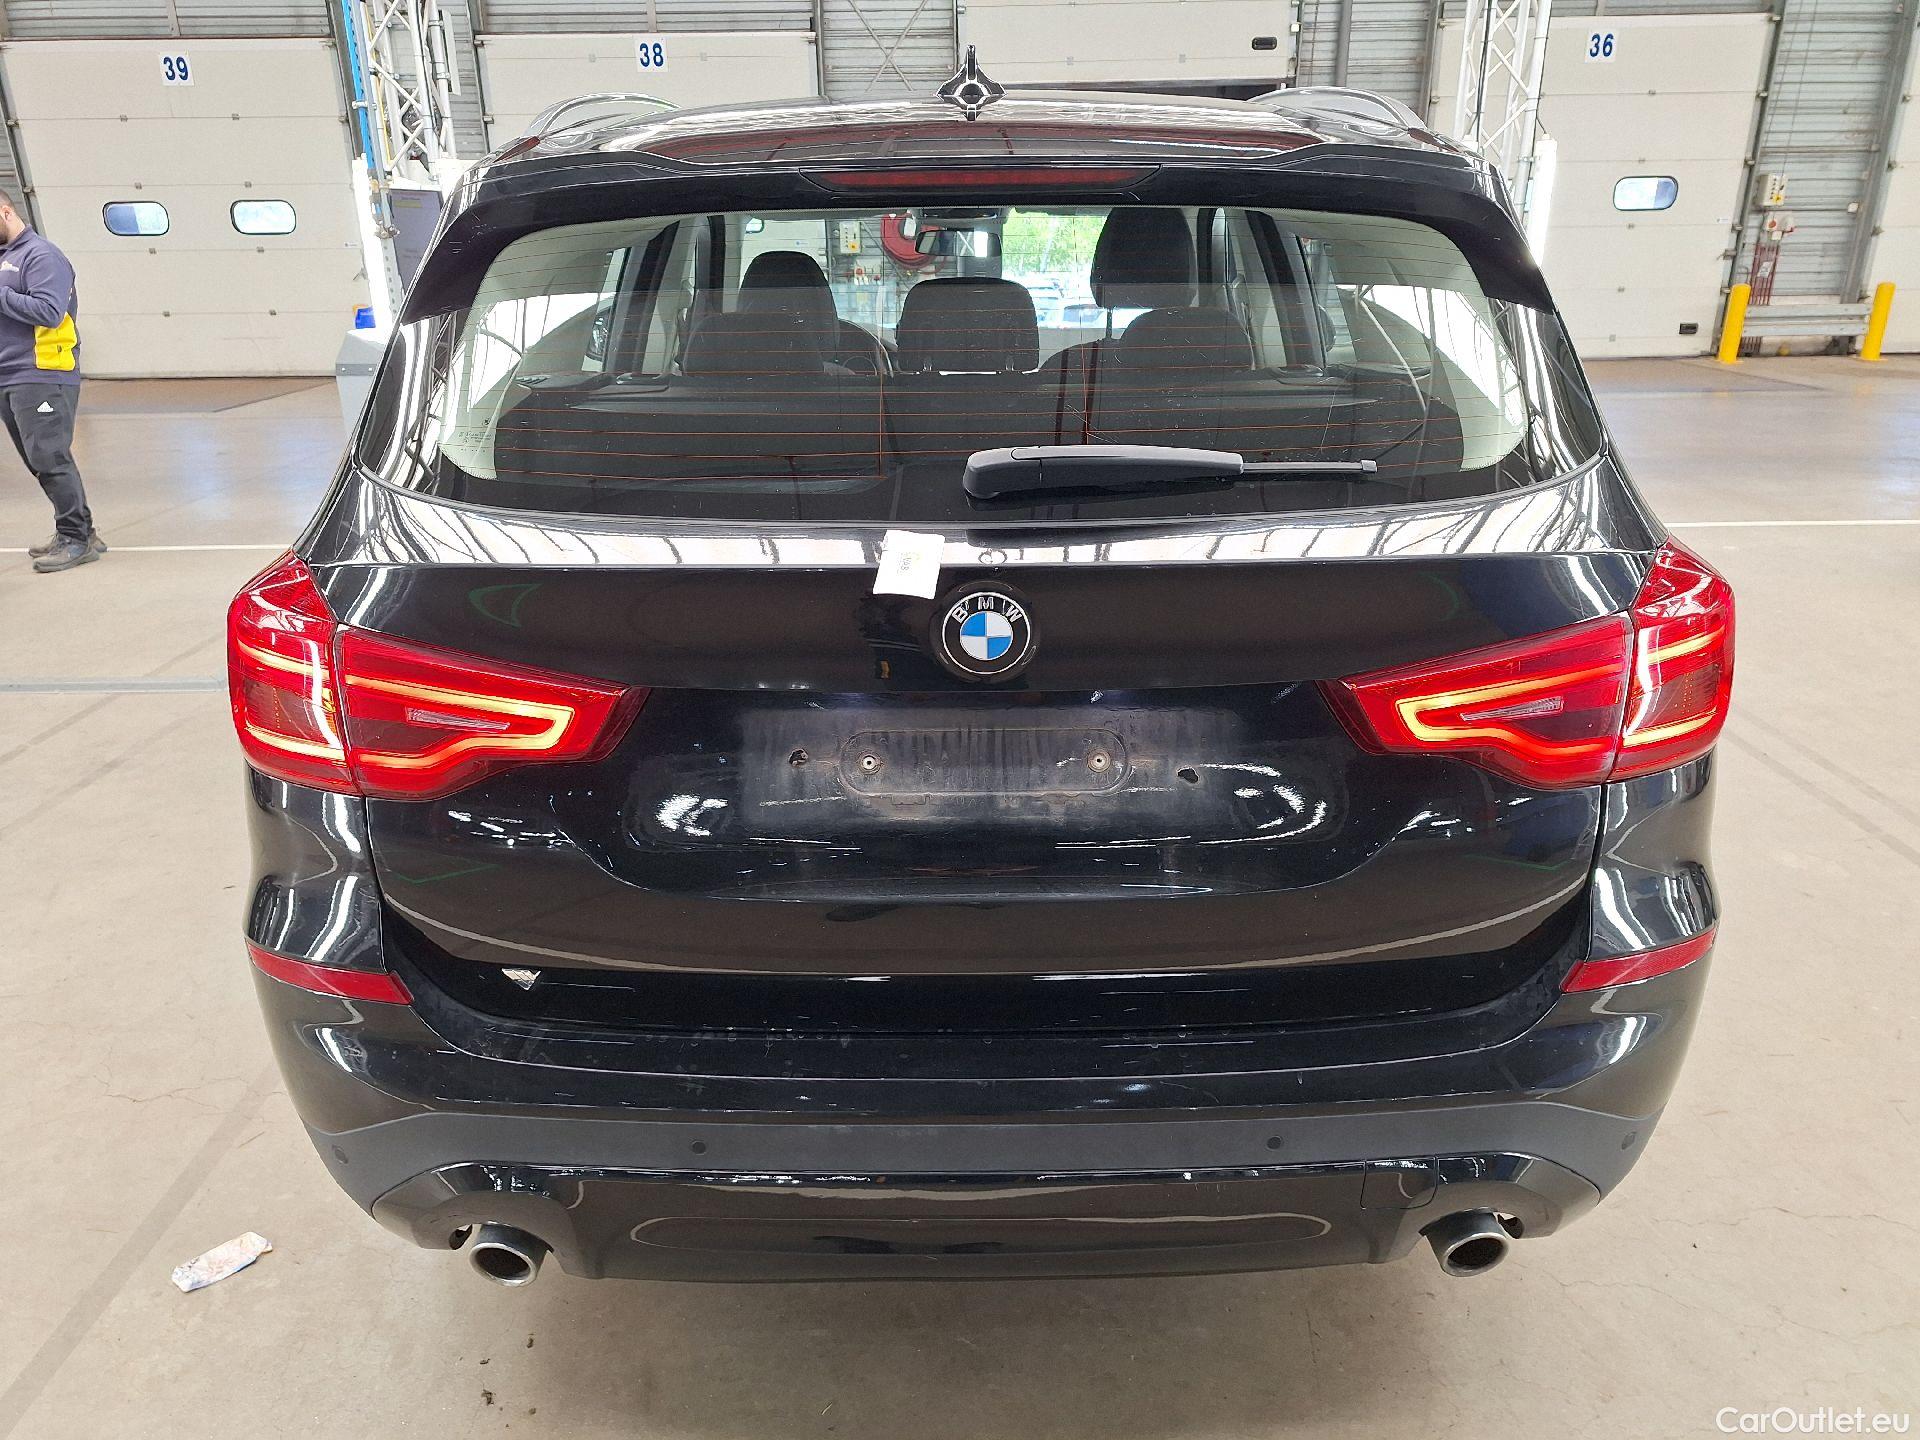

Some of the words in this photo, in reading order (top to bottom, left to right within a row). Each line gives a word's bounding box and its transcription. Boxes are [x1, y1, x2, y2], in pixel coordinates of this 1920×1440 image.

[639, 42, 664, 67] 38
[1589, 33, 1614, 57] 36
[163, 56, 189, 81] 39
[951, 596, 1023, 624] BMW
